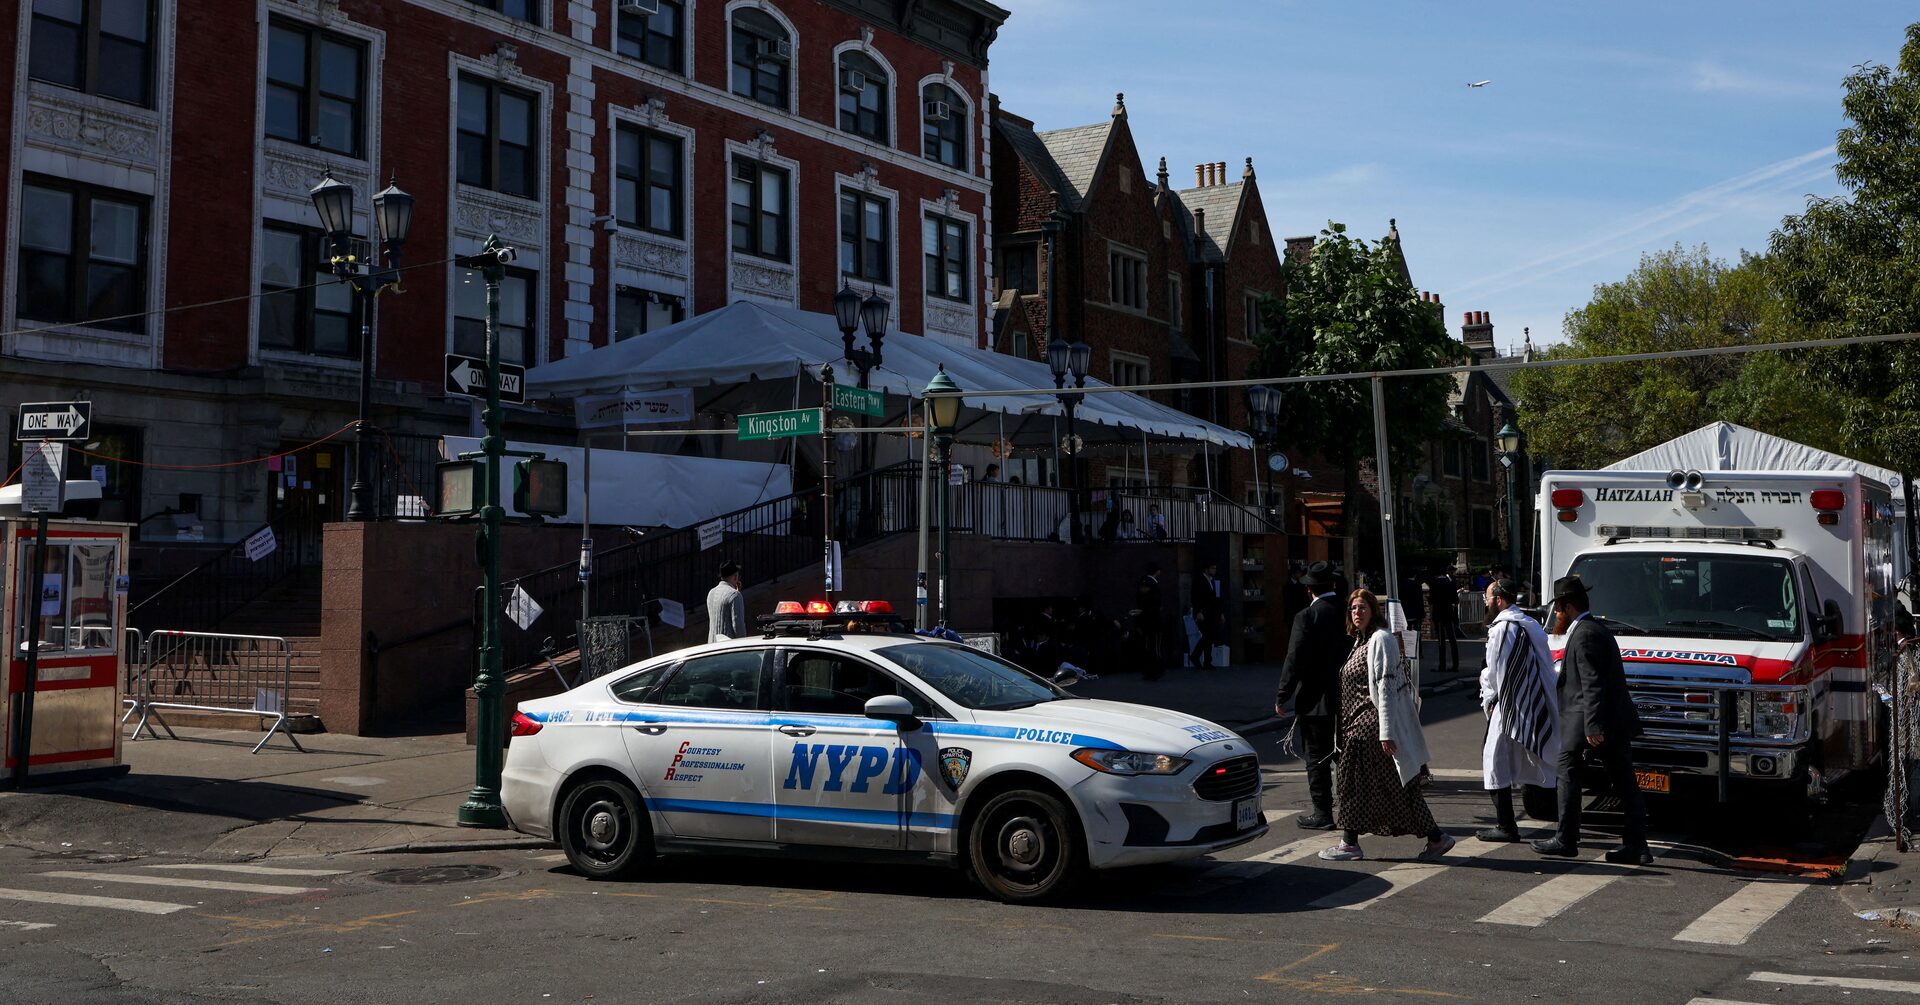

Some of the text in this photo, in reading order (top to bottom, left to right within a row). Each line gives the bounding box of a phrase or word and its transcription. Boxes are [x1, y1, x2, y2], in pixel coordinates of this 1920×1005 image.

[470, 370, 487, 386] ON
[835, 388, 880, 410] Eastern Pkwy
[28, 414, 78, 428] ONE WAY
[749, 413, 810, 437] Kingston Av
[1016, 727, 1071, 744] POLICE
[1191, 730, 1231, 742] POLICE
[783, 743, 922, 795] NYPD
